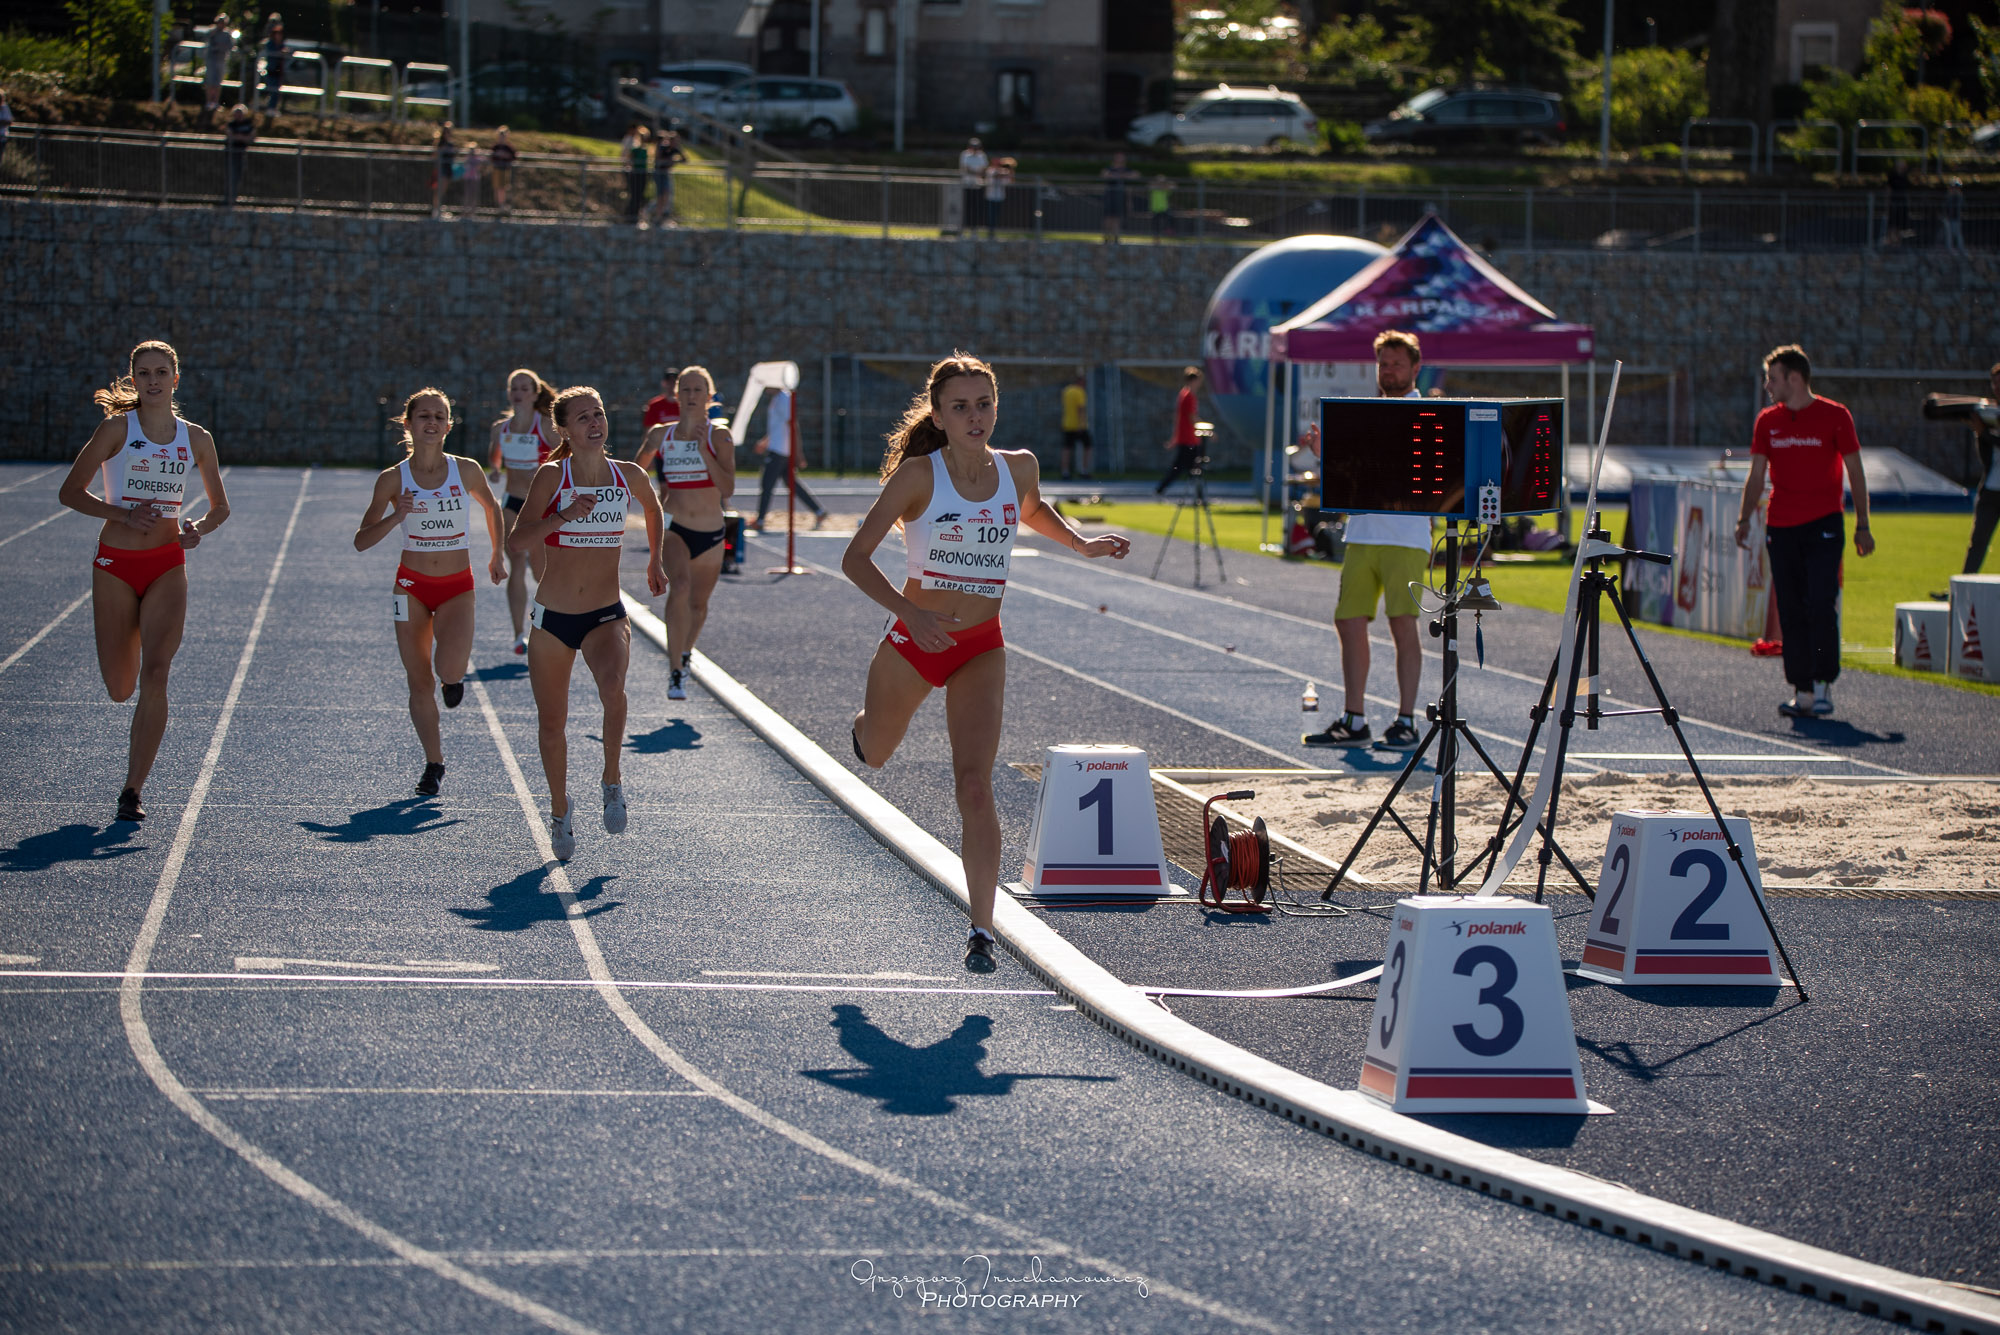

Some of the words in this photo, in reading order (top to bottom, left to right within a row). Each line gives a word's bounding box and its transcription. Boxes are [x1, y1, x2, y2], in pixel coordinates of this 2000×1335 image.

[160, 461, 185, 475] 110
[128, 478, 183, 493] PORĘBSKA
[596, 488, 624, 502] 509
[162, 504, 176, 513] 2020
[437, 498, 463, 512] 111
[421, 519, 455, 531] SOWA
[935, 513, 962, 523] 4F
[941, 534, 962, 542] ORLEN
[977, 526, 1009, 543] 109
[447, 539, 460, 547] 2020
[96, 557, 113, 567] 4F
[929, 549, 1005, 568] BRONOWSKA
[398, 578, 415, 587] 4F
[934, 580, 976, 593] KARPACZ
[978, 586, 996, 594] 2020
[394, 600, 401, 616] 1
[890, 631, 909, 644] 4F
[1086, 760, 1129, 773] polanik
[1079, 778, 1113, 855] 1
[1600, 843, 1630, 935] 2
[1670, 848, 1730, 940] 2
[1467, 921, 1527, 938] polanik
[1380, 939, 1406, 1050] 3
[1452, 944, 1525, 1057] 3
